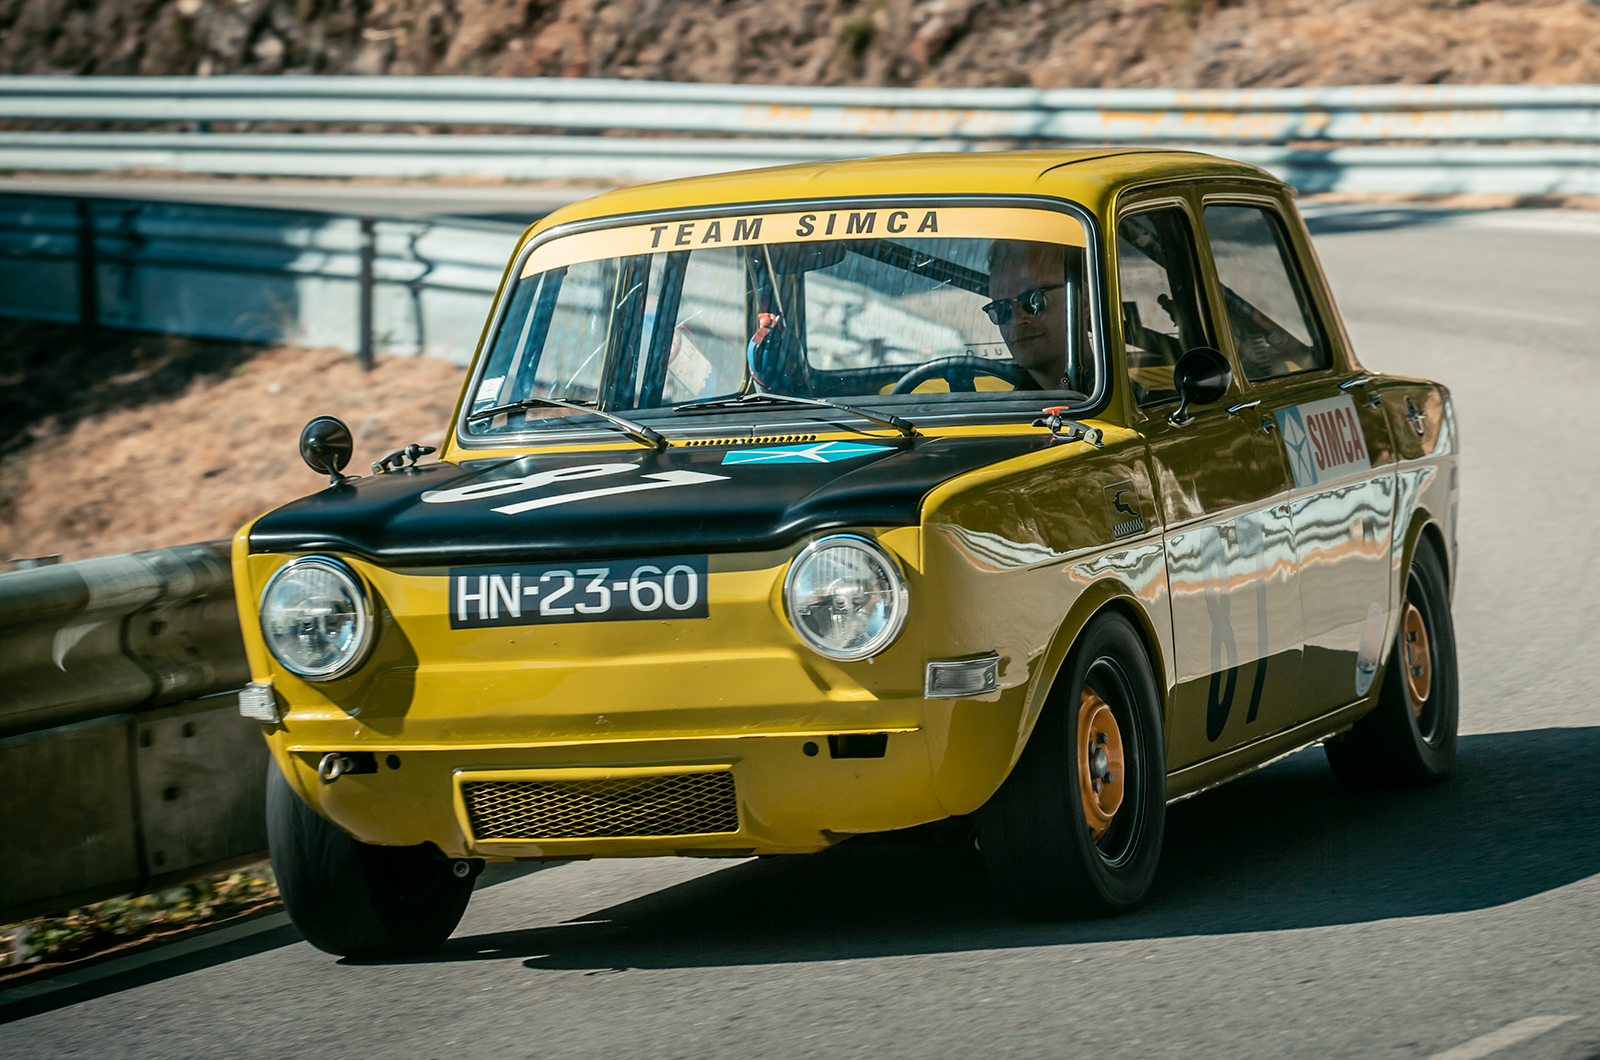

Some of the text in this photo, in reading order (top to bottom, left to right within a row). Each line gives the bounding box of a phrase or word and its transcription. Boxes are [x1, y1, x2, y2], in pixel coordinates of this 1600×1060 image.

[650, 211, 939, 248] TEAM SIMCA
[1306, 406, 1366, 471] SIMCA
[421, 463, 731, 515] 87
[457, 564, 699, 621] HN-23-60
[1201, 512, 1269, 742] 87
